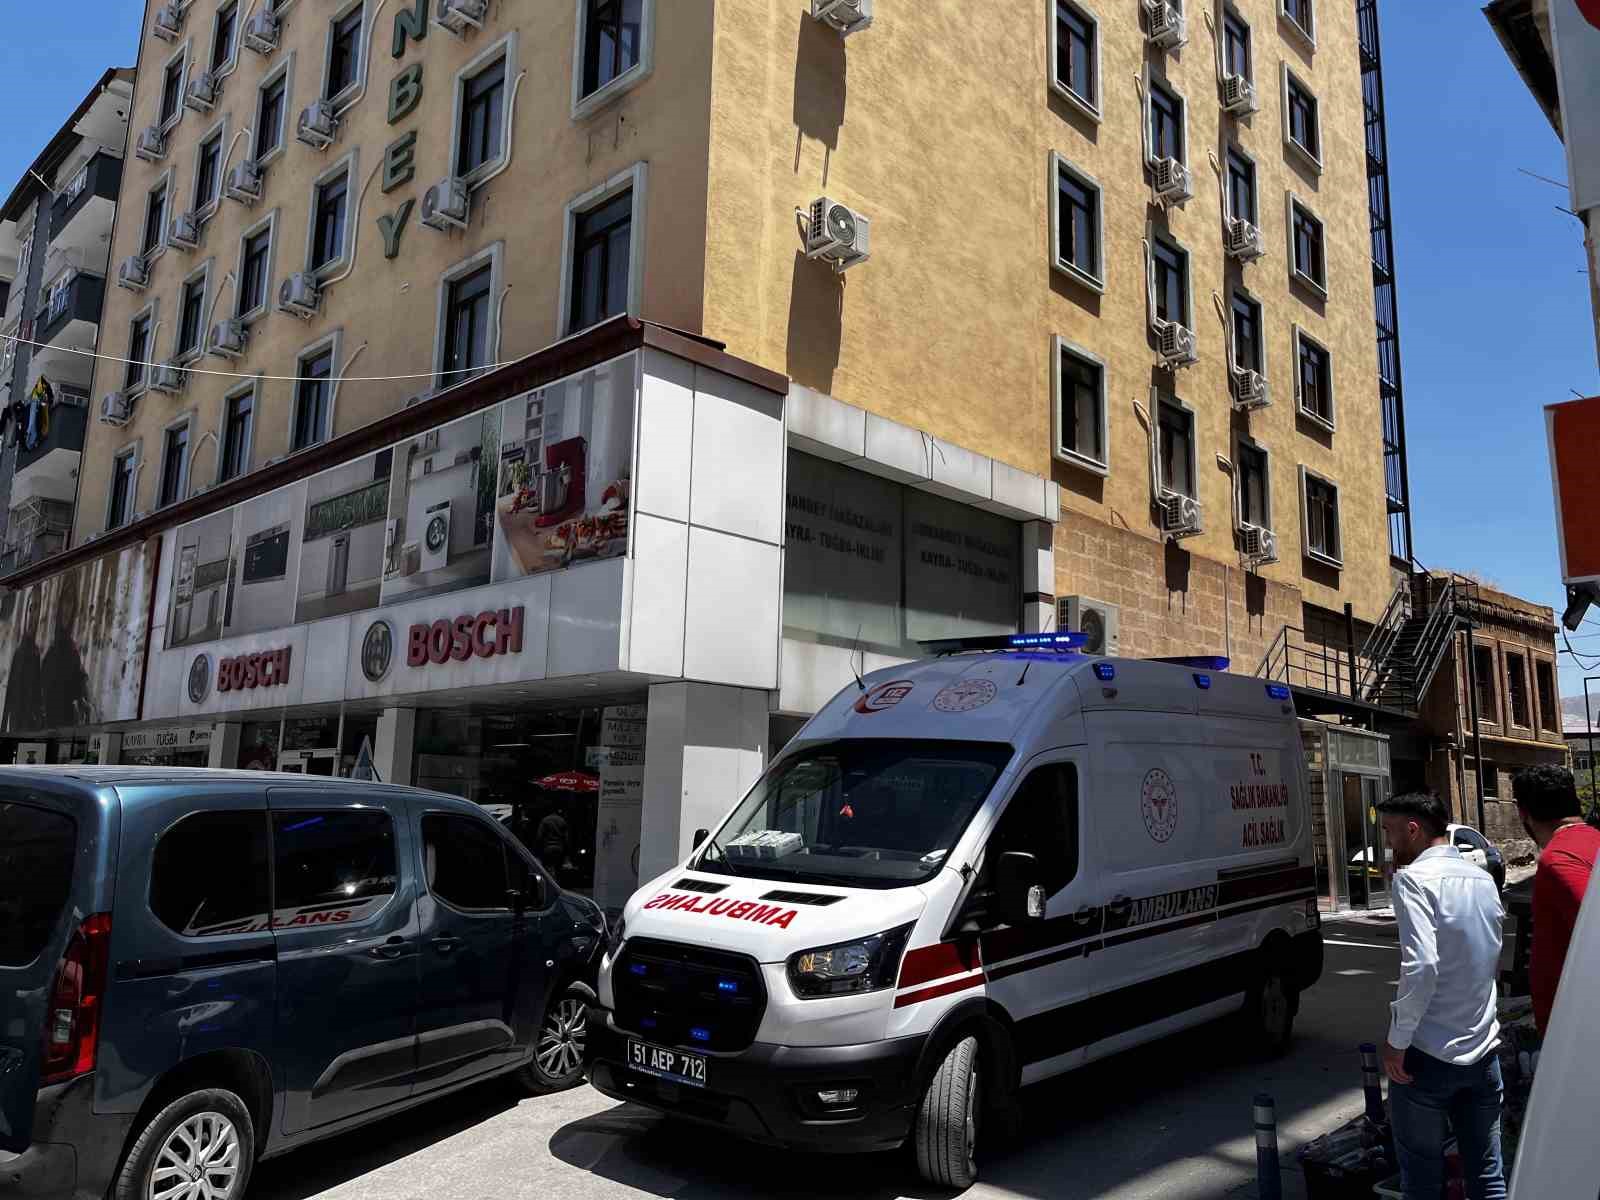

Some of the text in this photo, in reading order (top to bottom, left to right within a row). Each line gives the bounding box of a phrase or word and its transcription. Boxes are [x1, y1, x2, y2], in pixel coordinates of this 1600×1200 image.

[407, 606, 525, 667] BOSCH
[217, 645, 291, 692] BOSCH
[1250, 752, 1266, 776] T.C.
[1230, 780, 1256, 809] SAĞLIK
[1242, 816, 1286, 848] ACİL SAĞLIK
[1127, 886, 1216, 926] AMBULANS
[634, 1044, 646, 1064] 51
[651, 1049, 674, 1071] AEP
[682, 1056, 704, 1080] 712
